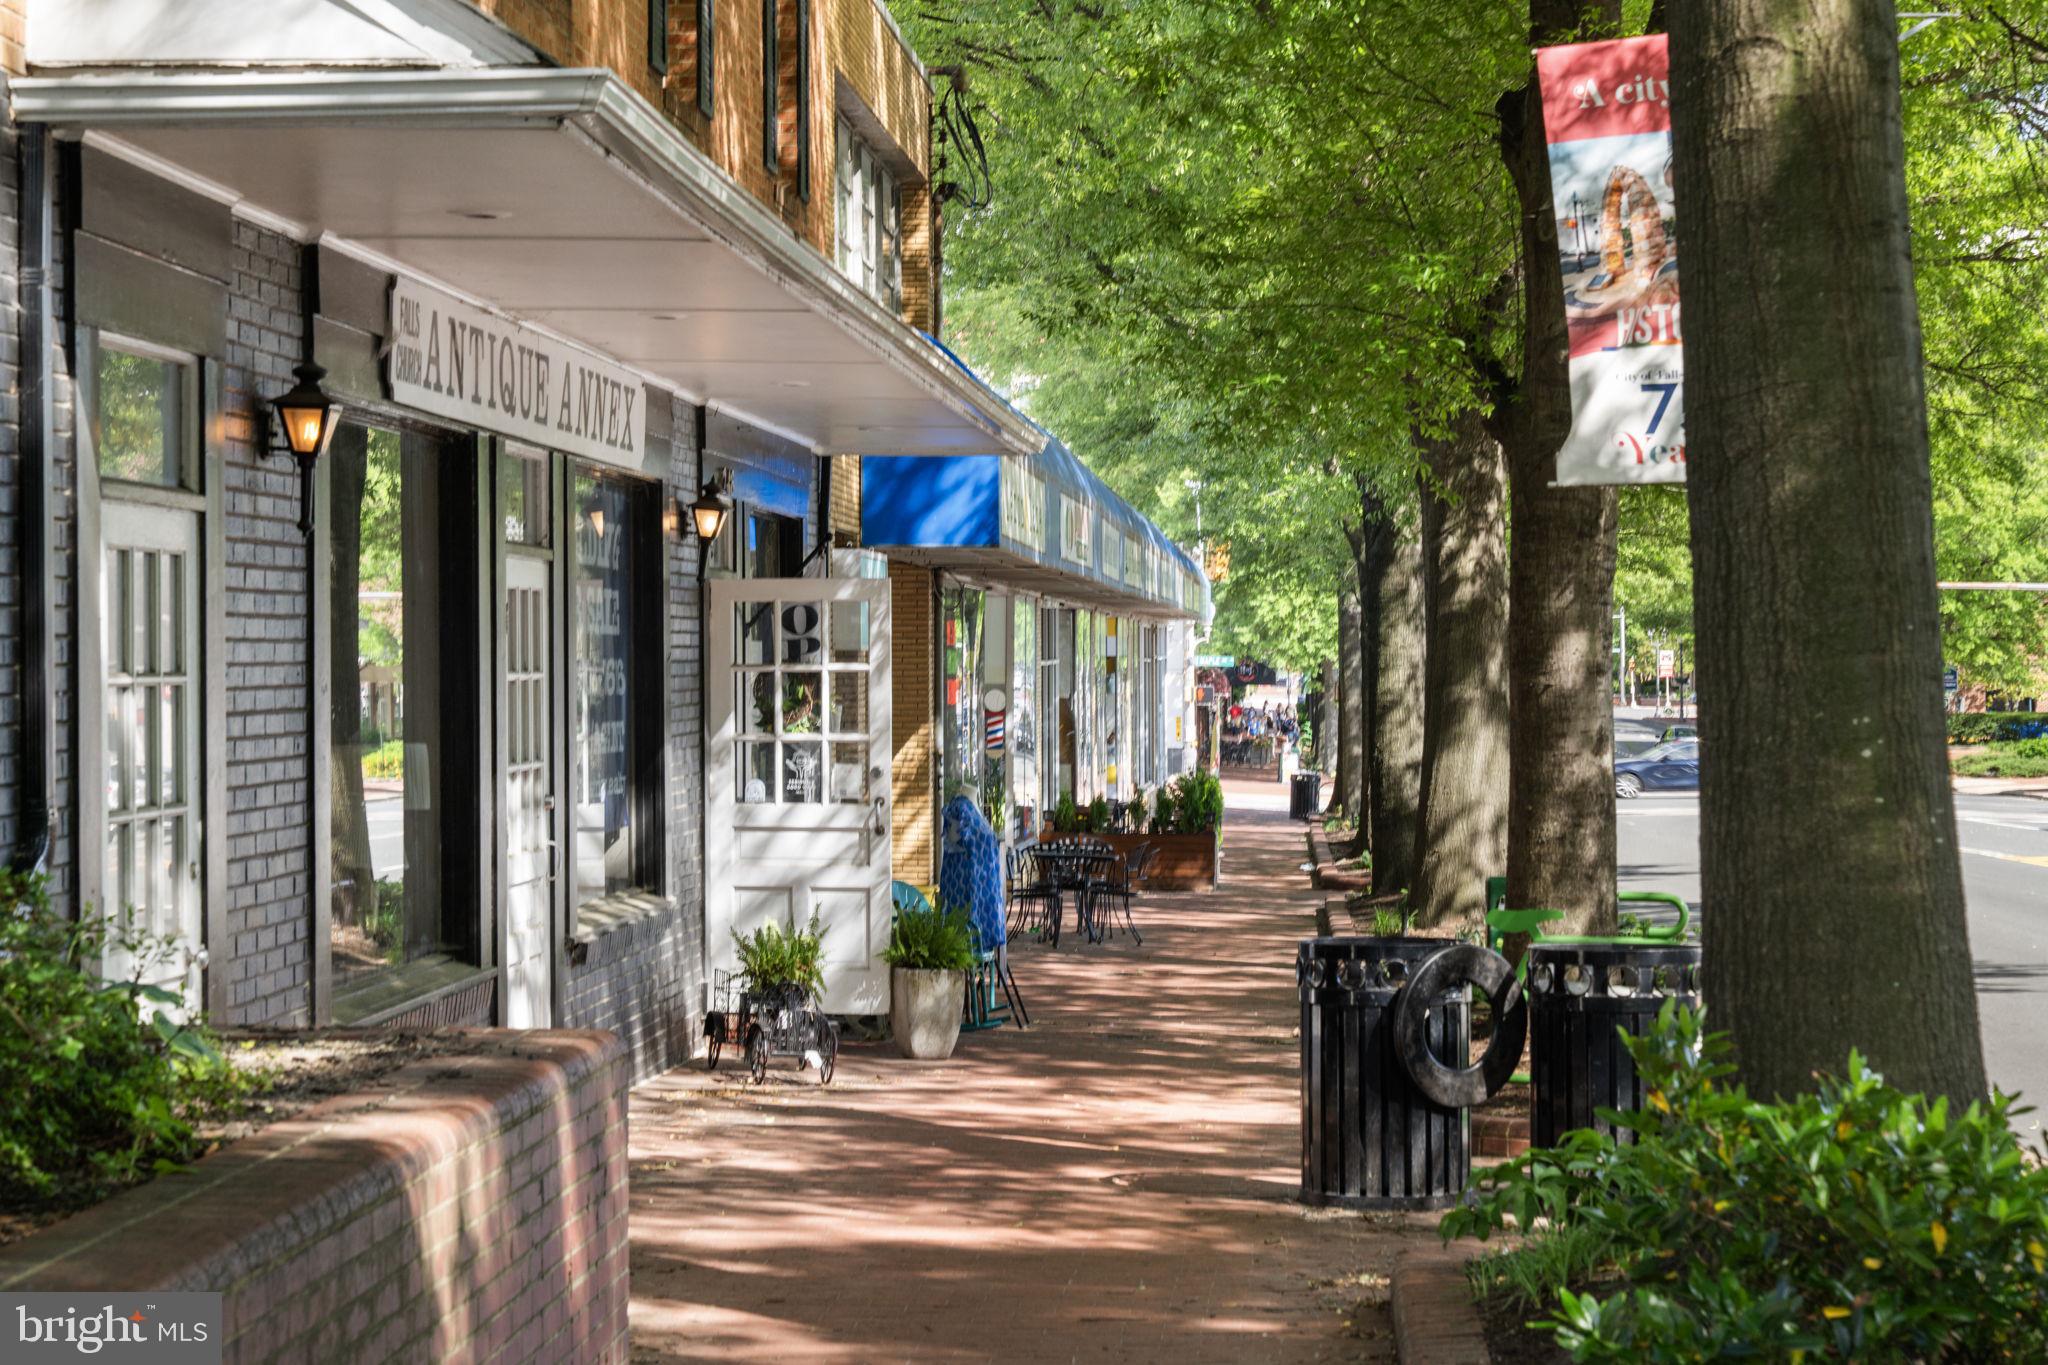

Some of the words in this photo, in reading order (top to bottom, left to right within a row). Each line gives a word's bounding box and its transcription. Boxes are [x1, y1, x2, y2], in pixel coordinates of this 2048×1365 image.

[1573, 79, 1605, 109] A
[400, 296, 420, 338] FALLS
[396, 343, 422, 386] CHURCH
[423, 310, 549, 426] ANTIQUE
[557, 361, 635, 452] ANNEX
[1656, 368, 1682, 380] Fall
[1613, 431, 1686, 465] Yea
